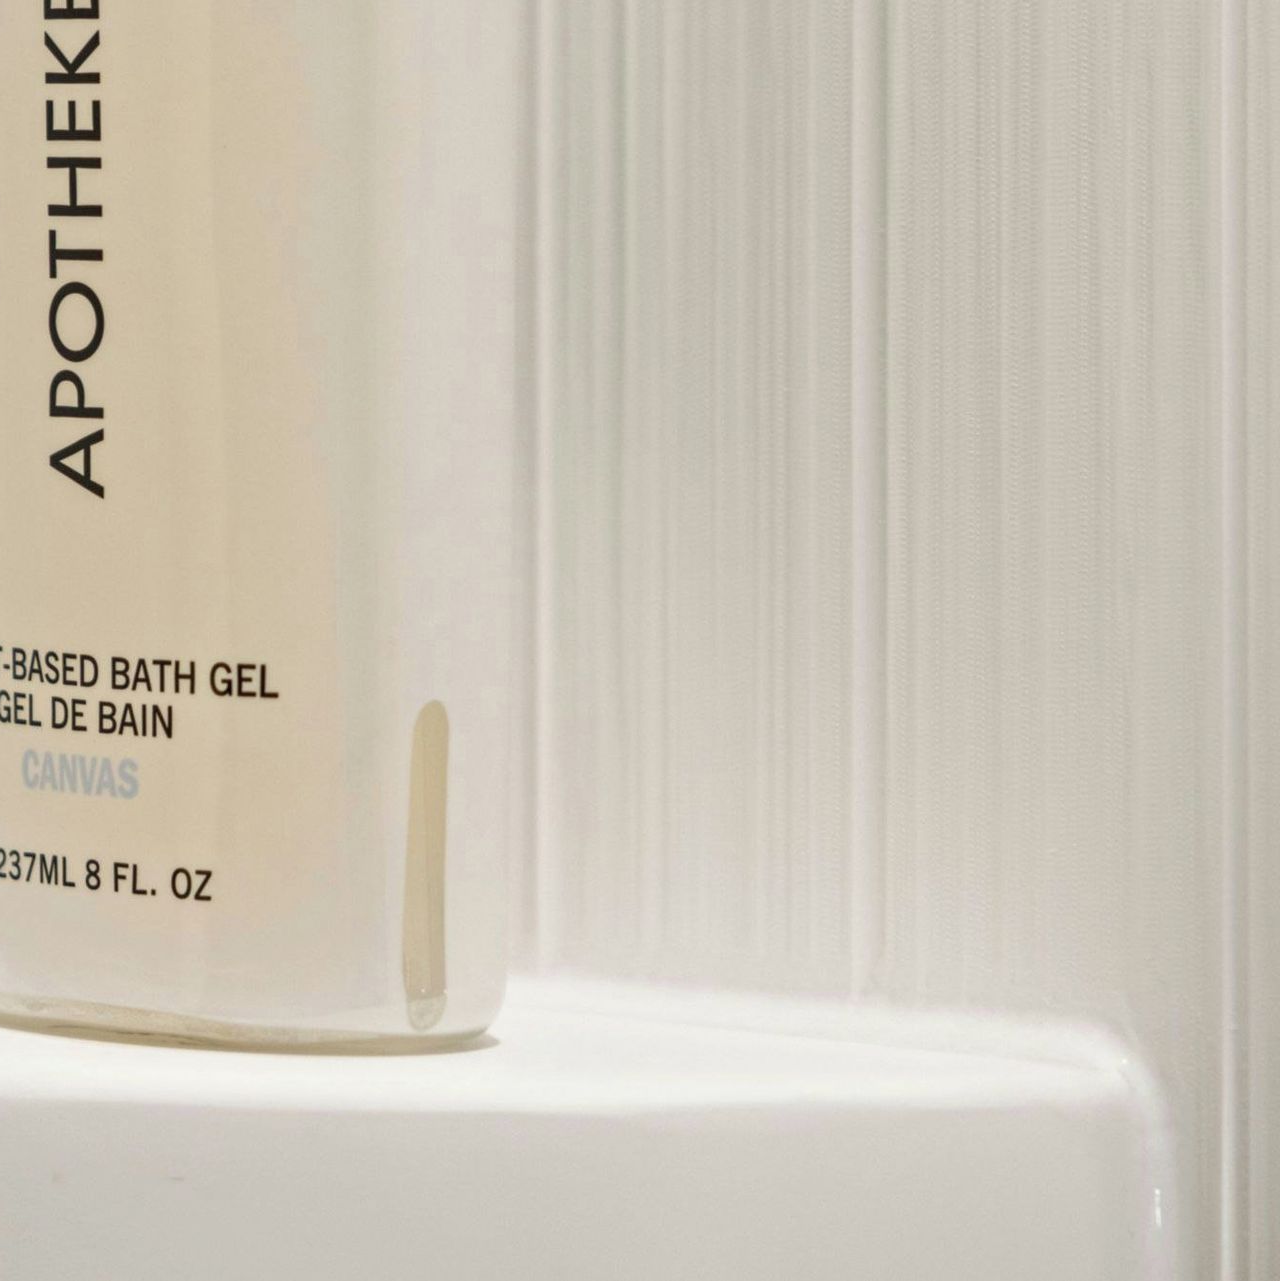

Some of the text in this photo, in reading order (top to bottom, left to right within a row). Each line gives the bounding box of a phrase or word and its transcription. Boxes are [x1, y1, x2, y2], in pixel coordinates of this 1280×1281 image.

[110, 656, 196, 695] BATH
[209, 662, 280, 699] GEL
[50, 695, 87, 732] DE
[97, 701, 174, 740] BAIN
[20, 748, 140, 800] CANVAS
[84, 858, 102, 891] 8
[112, 861, 157, 897] FL.
[170, 866, 213, 902] OZ
